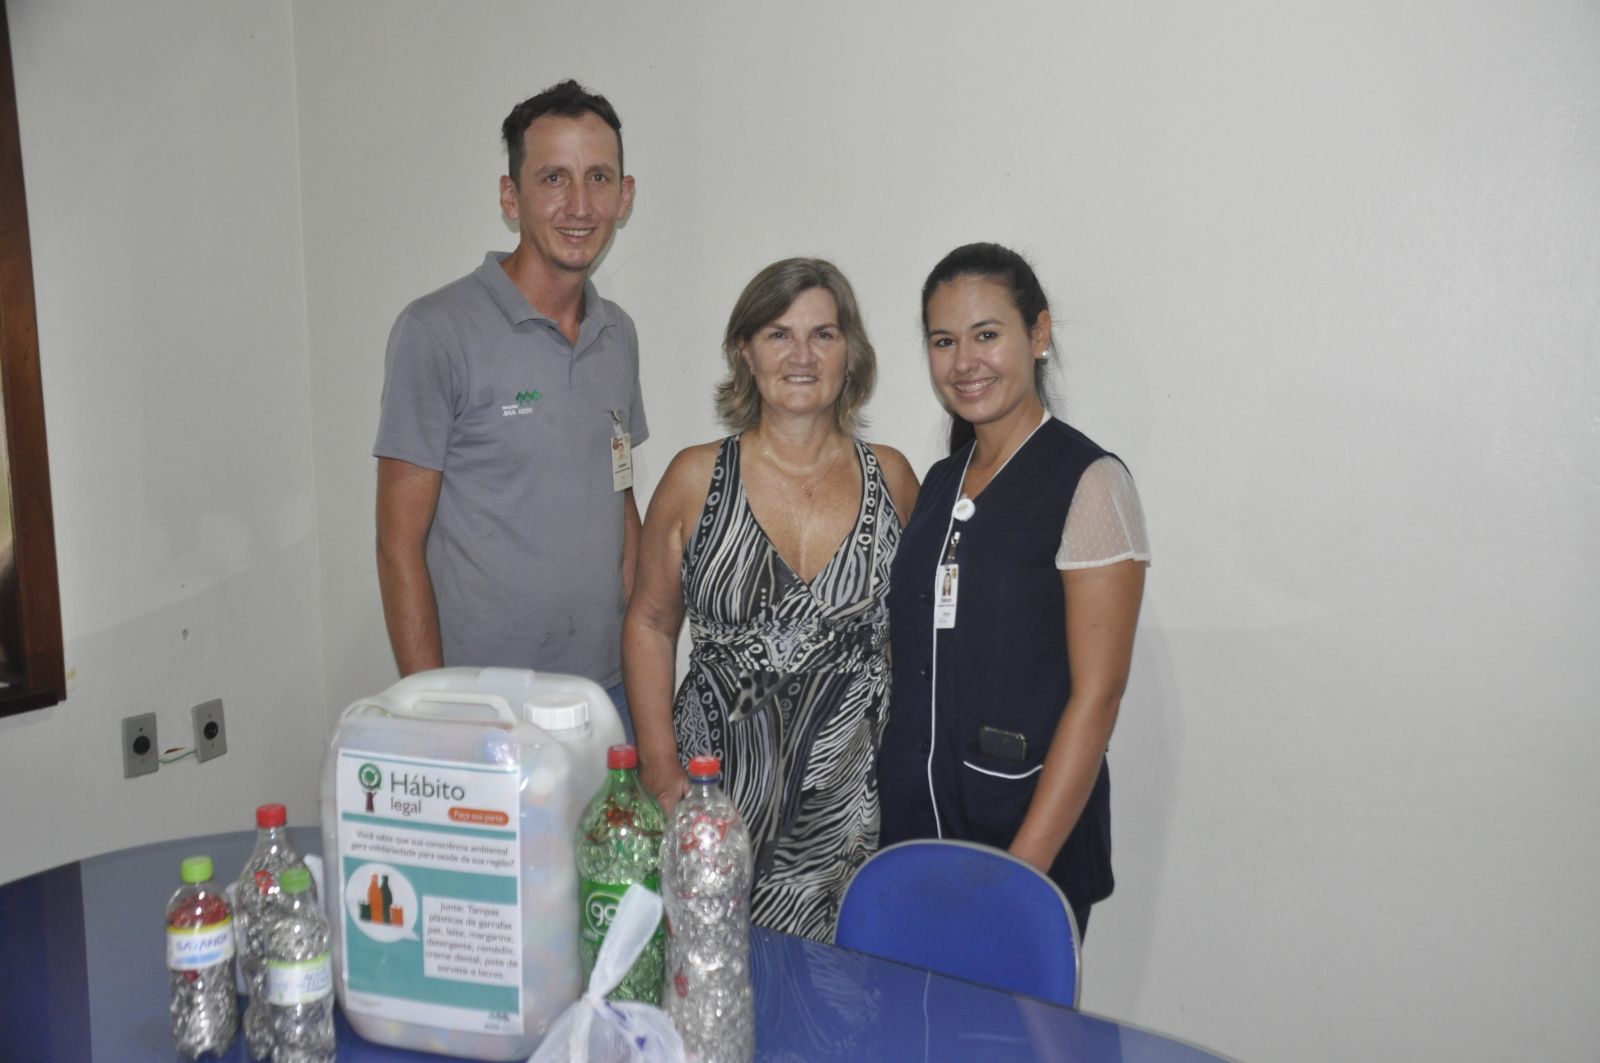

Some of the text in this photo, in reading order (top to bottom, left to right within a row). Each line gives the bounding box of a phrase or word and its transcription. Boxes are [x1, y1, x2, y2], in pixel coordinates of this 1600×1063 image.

[390, 771, 465, 801] Hábito
[390, 797, 422, 816] legal
[356, 830, 374, 841] Você
[395, 837, 410, 846] que
[411, 838, 424, 846] sua
[425, 840, 468, 852] consciência
[470, 844, 508, 856] ambiental
[368, 843, 417, 858] solidariedade
[418, 850, 435, 861] para
[436, 851, 459, 864] saúde
[471, 857, 484, 866] sua
[486, 857, 514, 870] região?
[468, 904, 500, 918] Tampas
[428, 913, 512, 932] plásticas de garrafas
[426, 938, 473, 951] detergente,
[468, 931, 514, 944] margarina,
[425, 951, 452, 961] creme
[506, 961, 518, 969] de
[437, 964, 469, 975] sorvete
